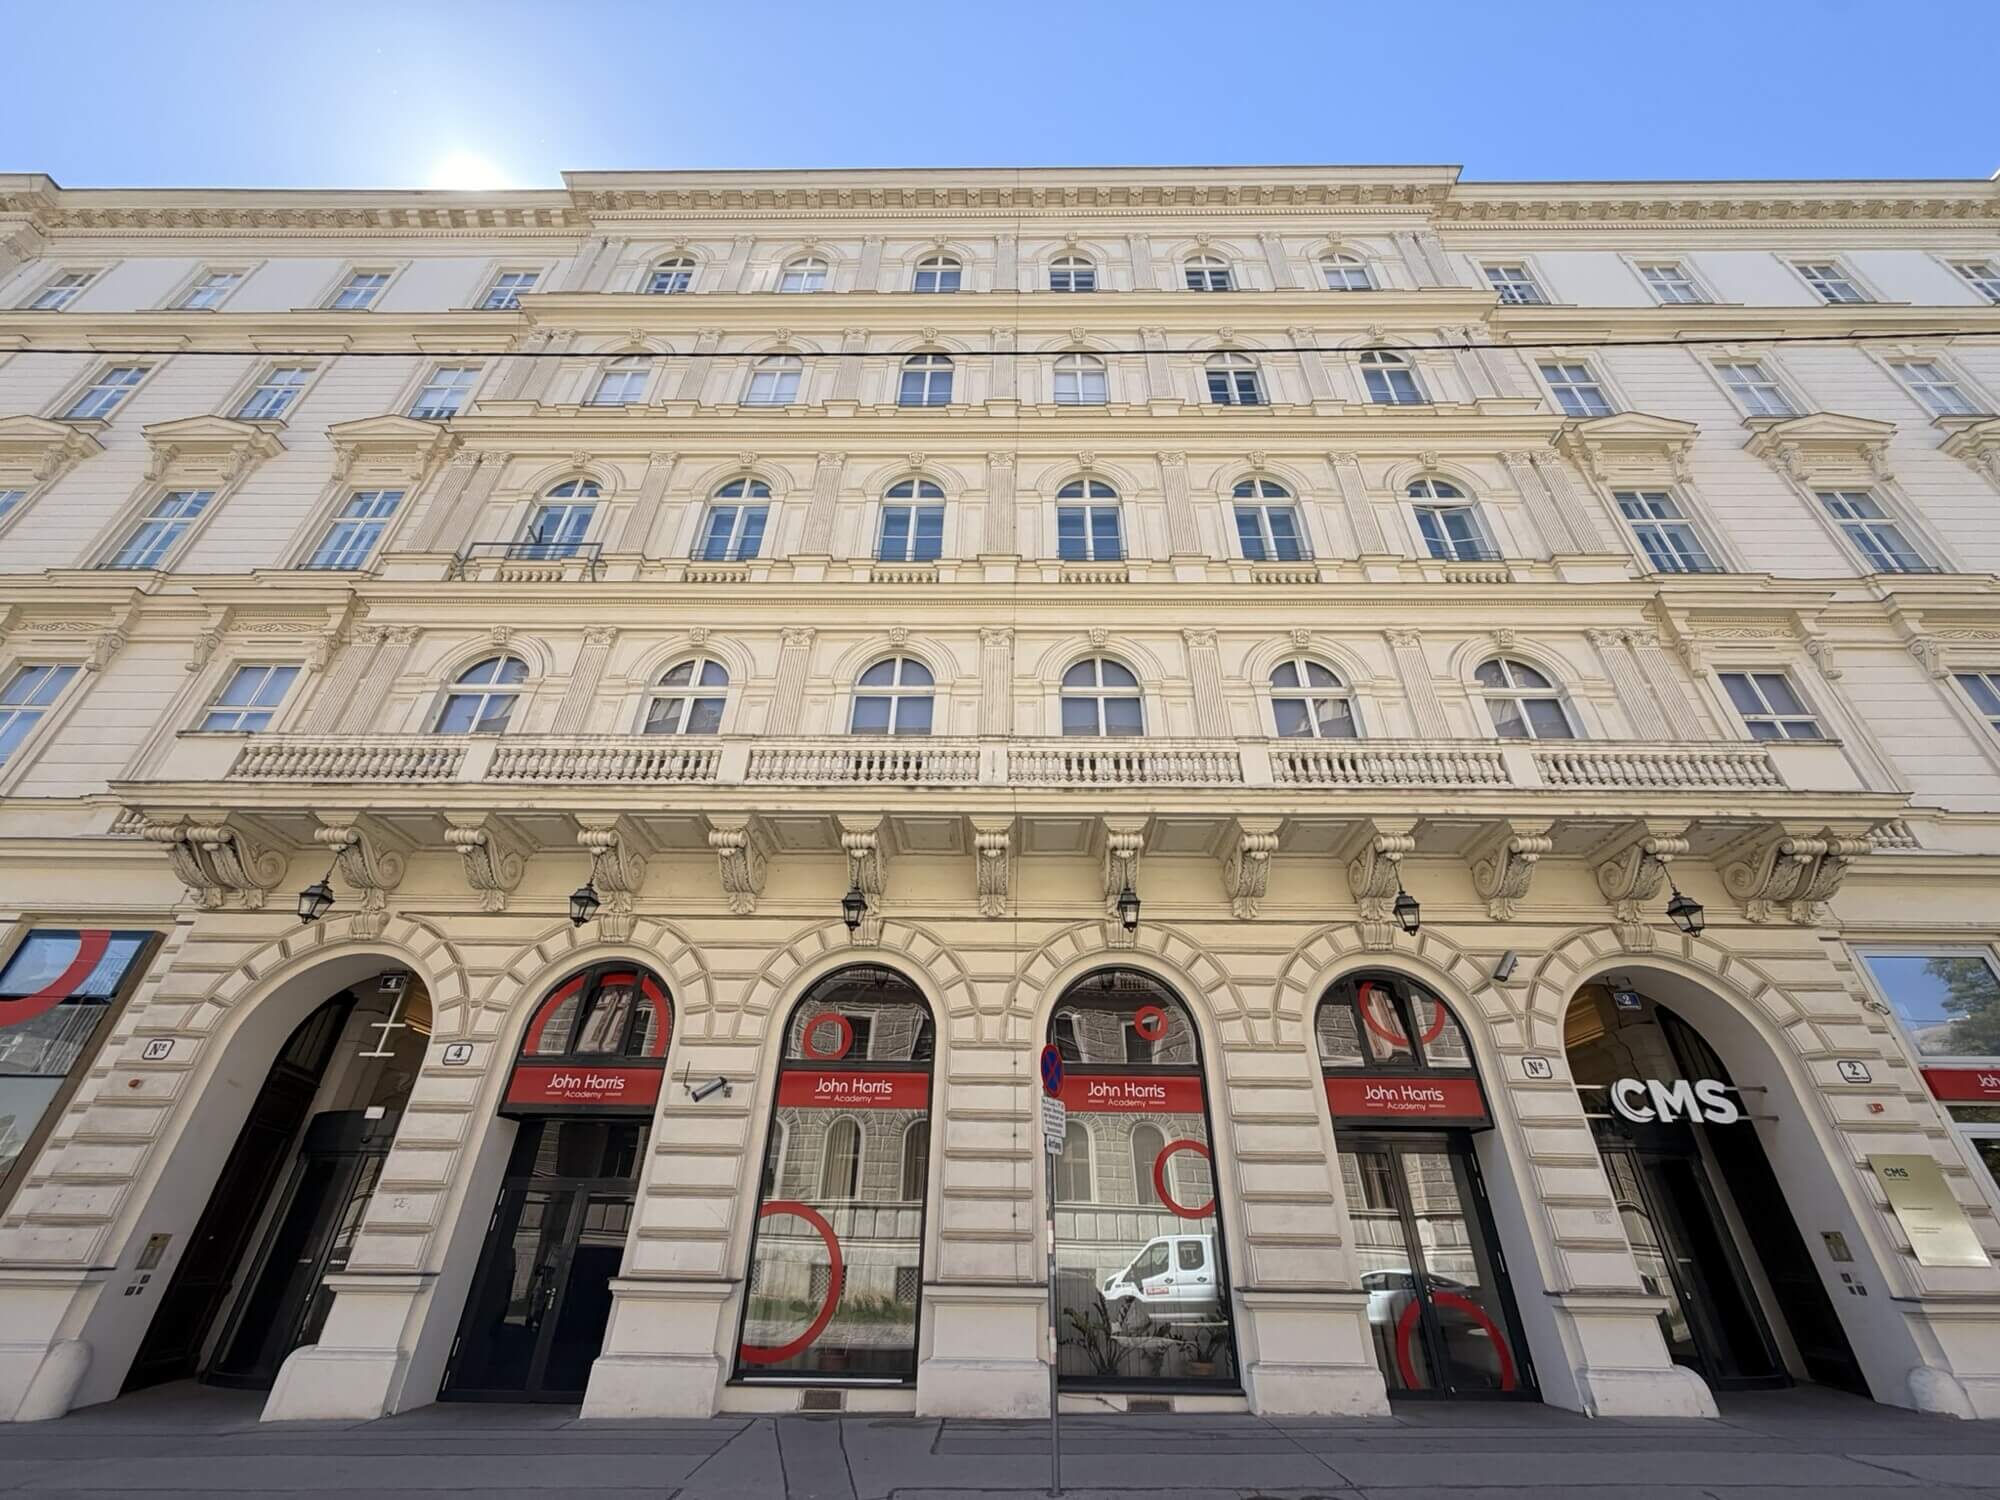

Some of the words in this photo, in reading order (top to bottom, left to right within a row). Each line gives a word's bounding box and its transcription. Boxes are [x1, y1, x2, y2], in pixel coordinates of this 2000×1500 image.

[453, 1045, 464, 1058] 4
[1847, 1062, 1861, 1076] 2
[547, 1073, 581, 1089] John
[584, 1074, 625, 1090] Harris
[815, 1078, 848, 1093] John
[852, 1078, 893, 1094] Harris
[1977, 1073, 2000, 1087] Joh
[564, 1090, 603, 1099] Academy
[1087, 1081, 1121, 1097] John
[1124, 1082, 1166, 1098] Harris
[1364, 1084, 1399, 1100] John
[1400, 1085, 1445, 1101] Harris
[833, 1094, 872, 1104] Academy
[1107, 1098, 1147, 1108] Academy
[1386, 1101, 1427, 1111] Academy
[1610, 1078, 1739, 1125] CMS
[1883, 1167, 1909, 1178] CMS
